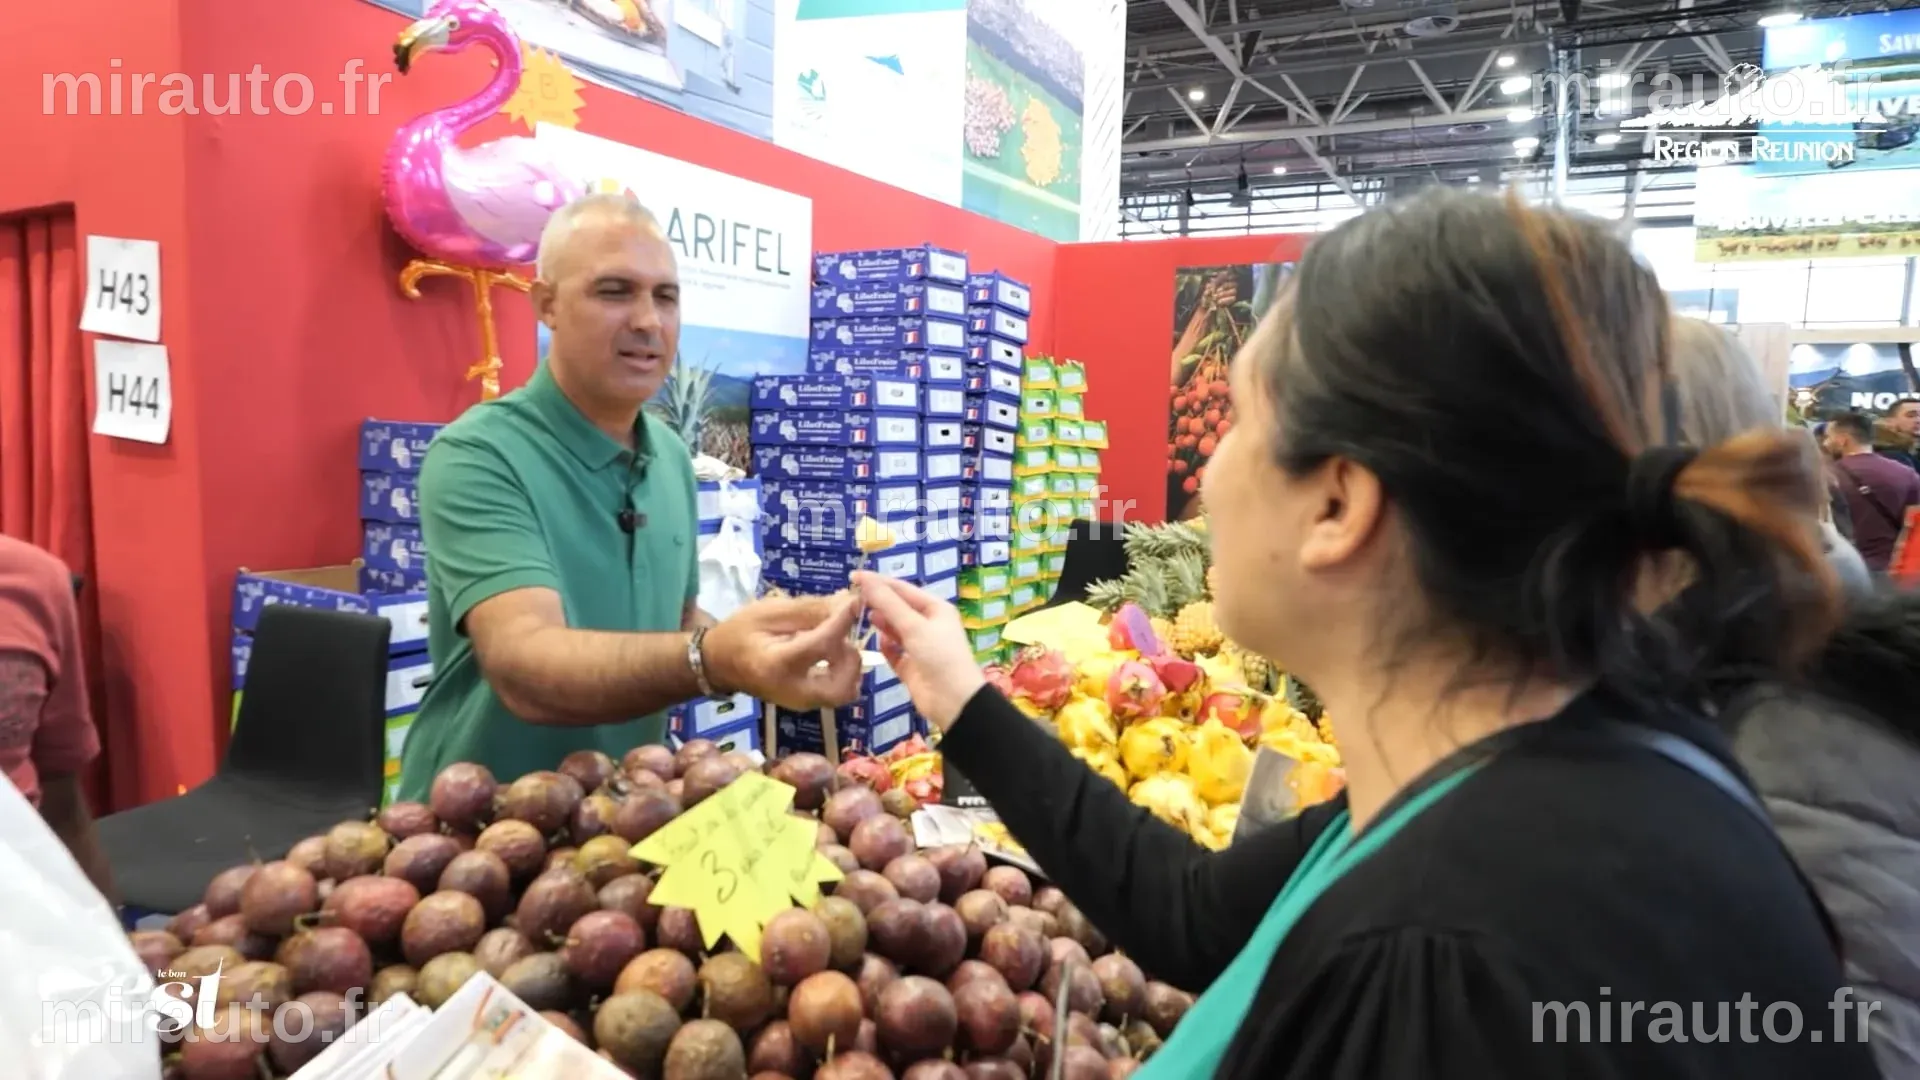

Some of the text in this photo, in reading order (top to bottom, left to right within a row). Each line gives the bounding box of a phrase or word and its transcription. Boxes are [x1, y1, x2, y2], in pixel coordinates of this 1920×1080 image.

[667, 207, 791, 276] ARIFEL
[97, 268, 150, 315] H43
[108, 371, 159, 419] H44
[701, 850, 738, 904] 3
